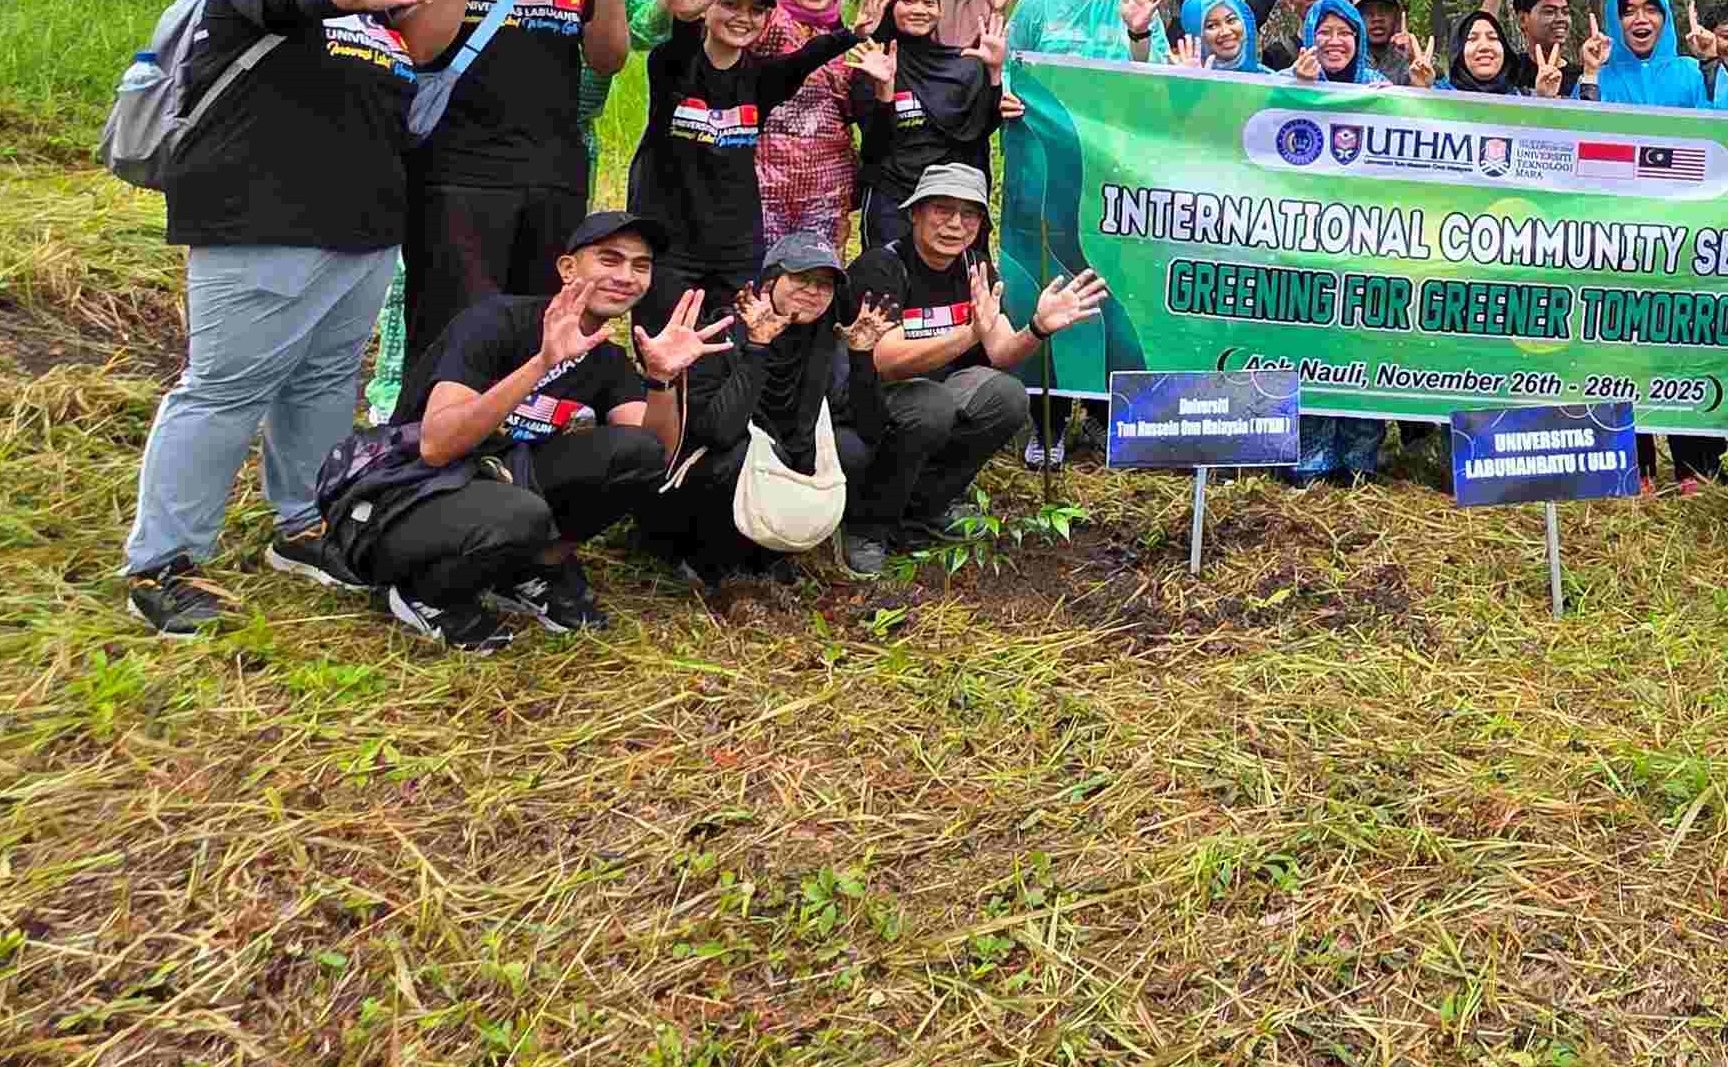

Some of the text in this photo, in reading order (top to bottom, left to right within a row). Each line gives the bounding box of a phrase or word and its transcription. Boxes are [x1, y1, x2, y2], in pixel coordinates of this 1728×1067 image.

[1366, 126, 1473, 162] UTHM
[1101, 184, 1431, 260] INTERNATIONAL
[1440, 211, 1689, 274] COMMUNITY
[1168, 258, 1337, 326] GREENING
[1342, 273, 1413, 330] FOR
[1420, 279, 1573, 340] GREENER
[1300, 359, 1368, 389] Nauli,
[1376, 363, 1504, 394] November
[1510, 372, 1562, 396] 26th
[1585, 375, 1642, 400] 28th,
[1494, 428, 1596, 453] UNIVERSITAS
[1465, 453, 1576, 480] LABUHANBATU
